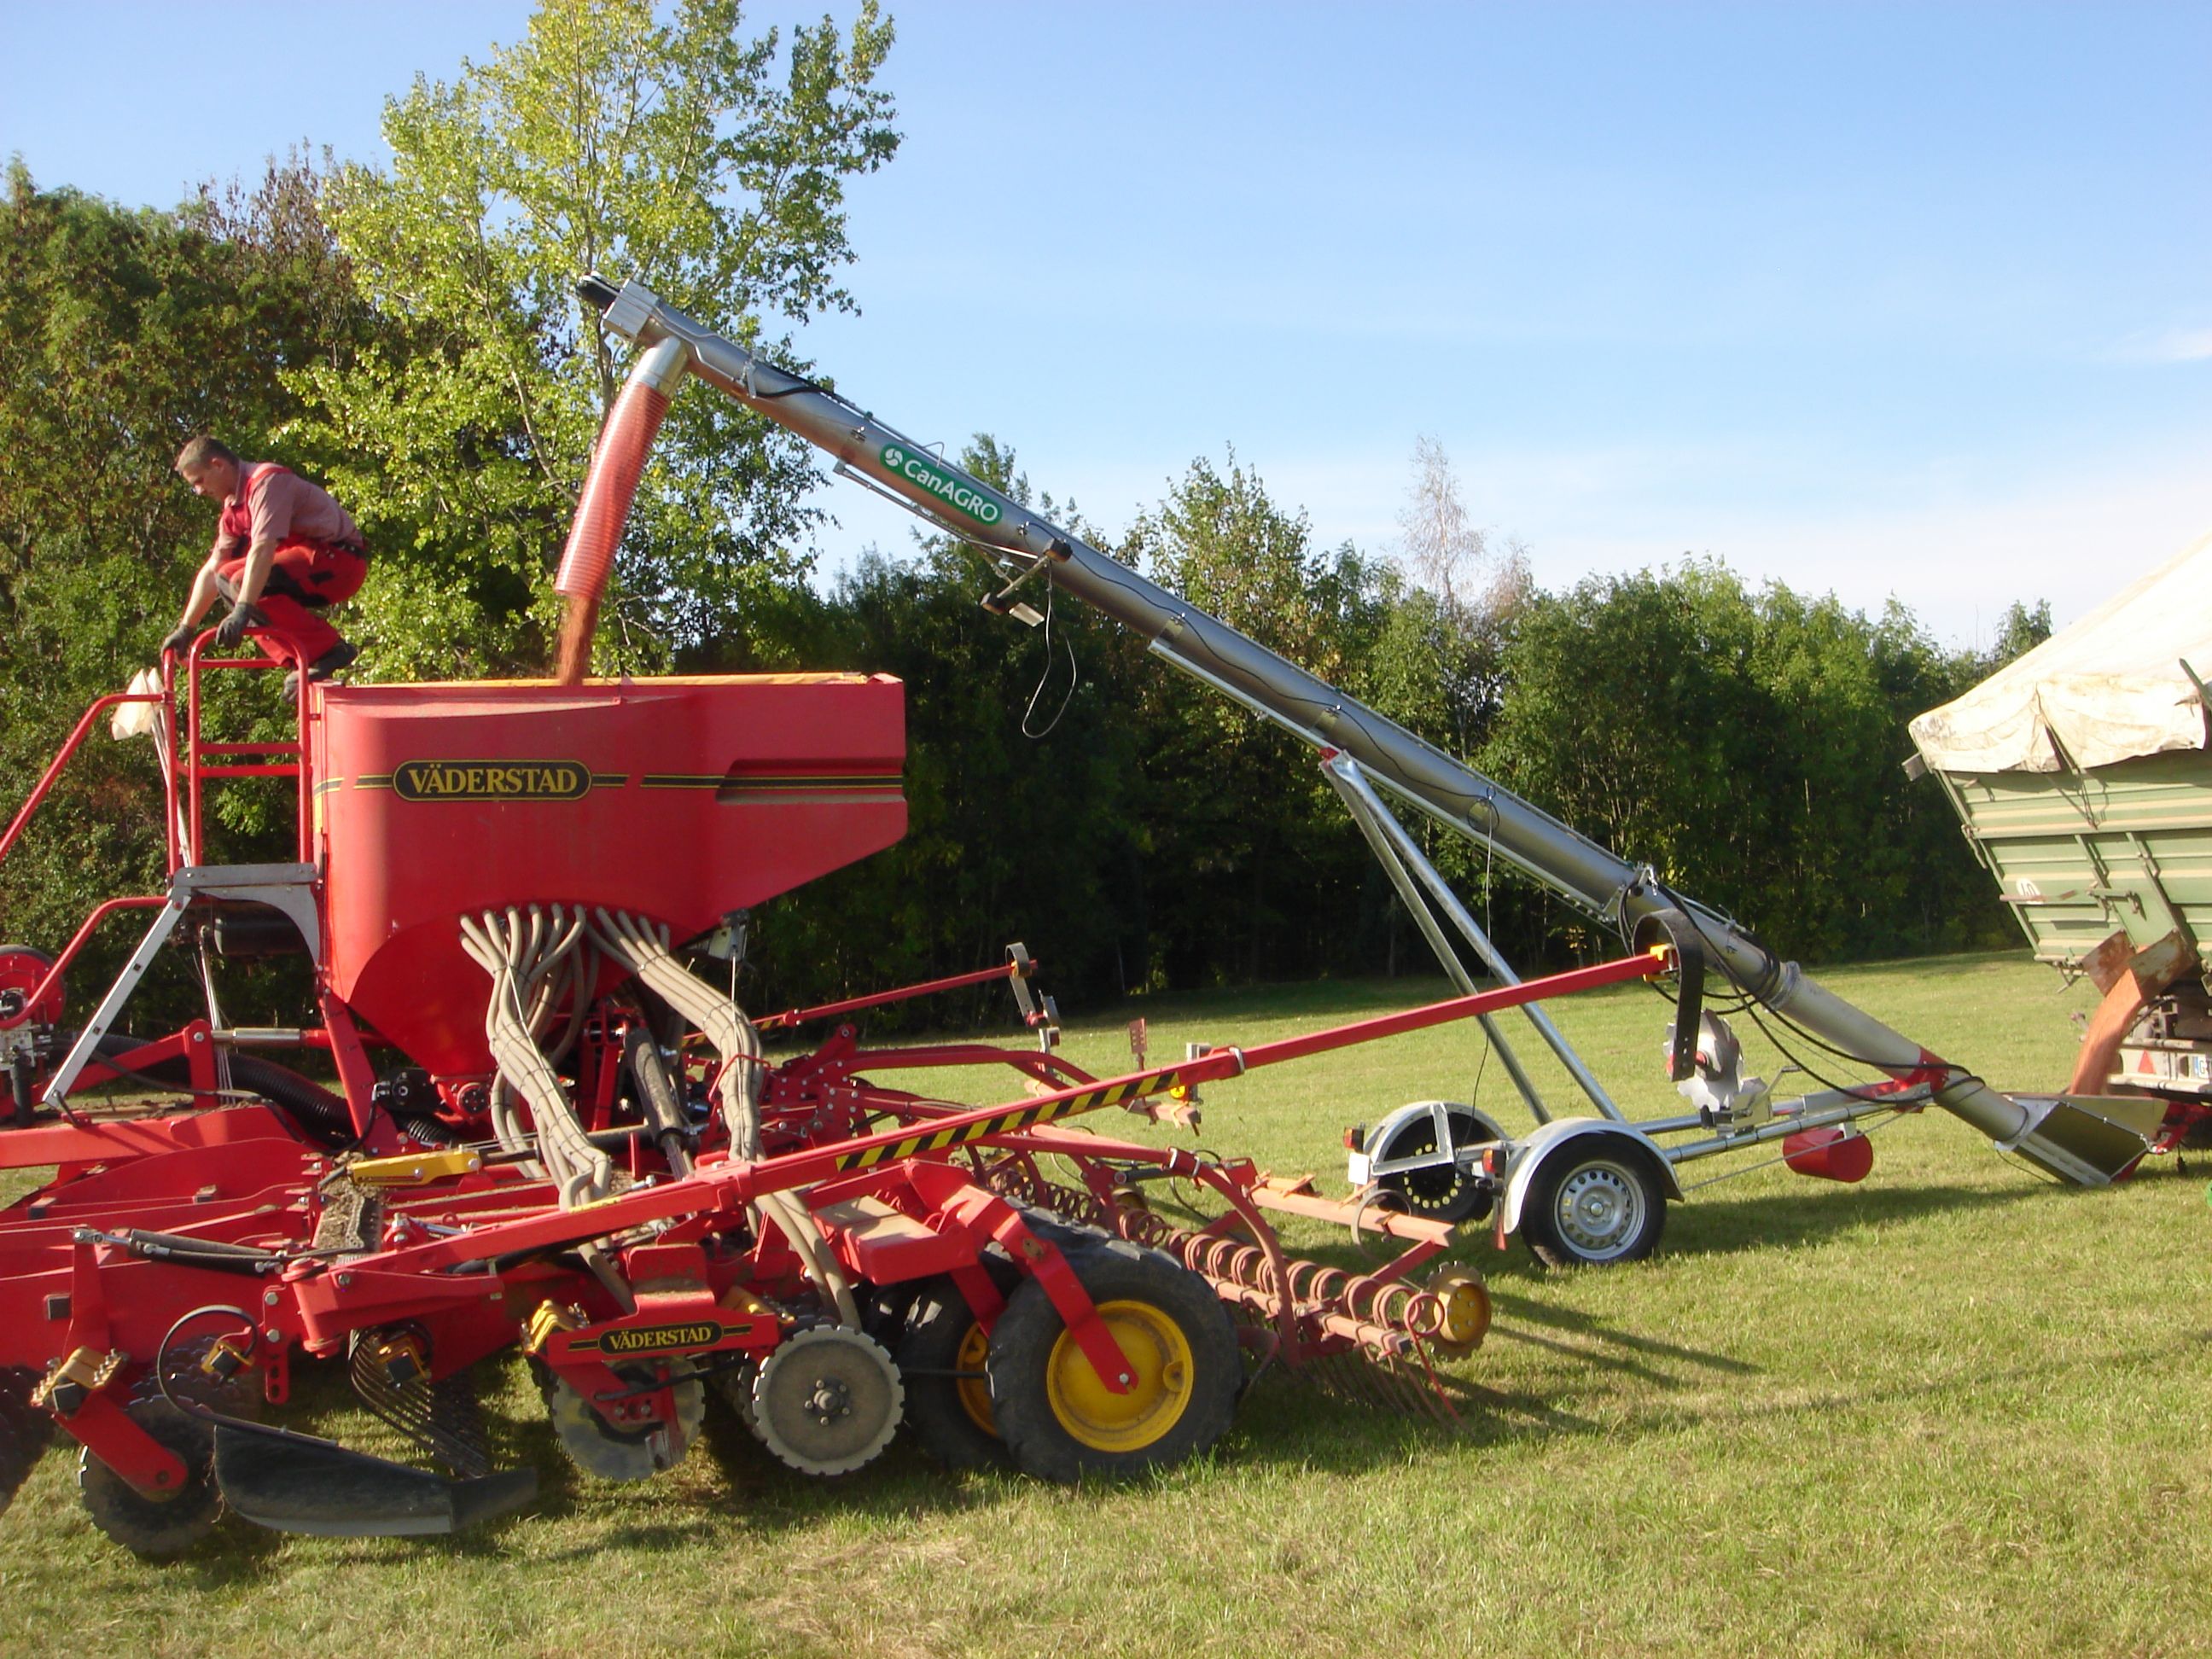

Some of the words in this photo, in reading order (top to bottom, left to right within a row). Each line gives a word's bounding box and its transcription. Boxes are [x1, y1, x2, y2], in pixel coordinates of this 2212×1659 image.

[904, 459, 998, 521] CanAGRO
[408, 764, 578, 793] VÄDERSTAD
[609, 1327, 711, 1349] VÄDERSTAD
